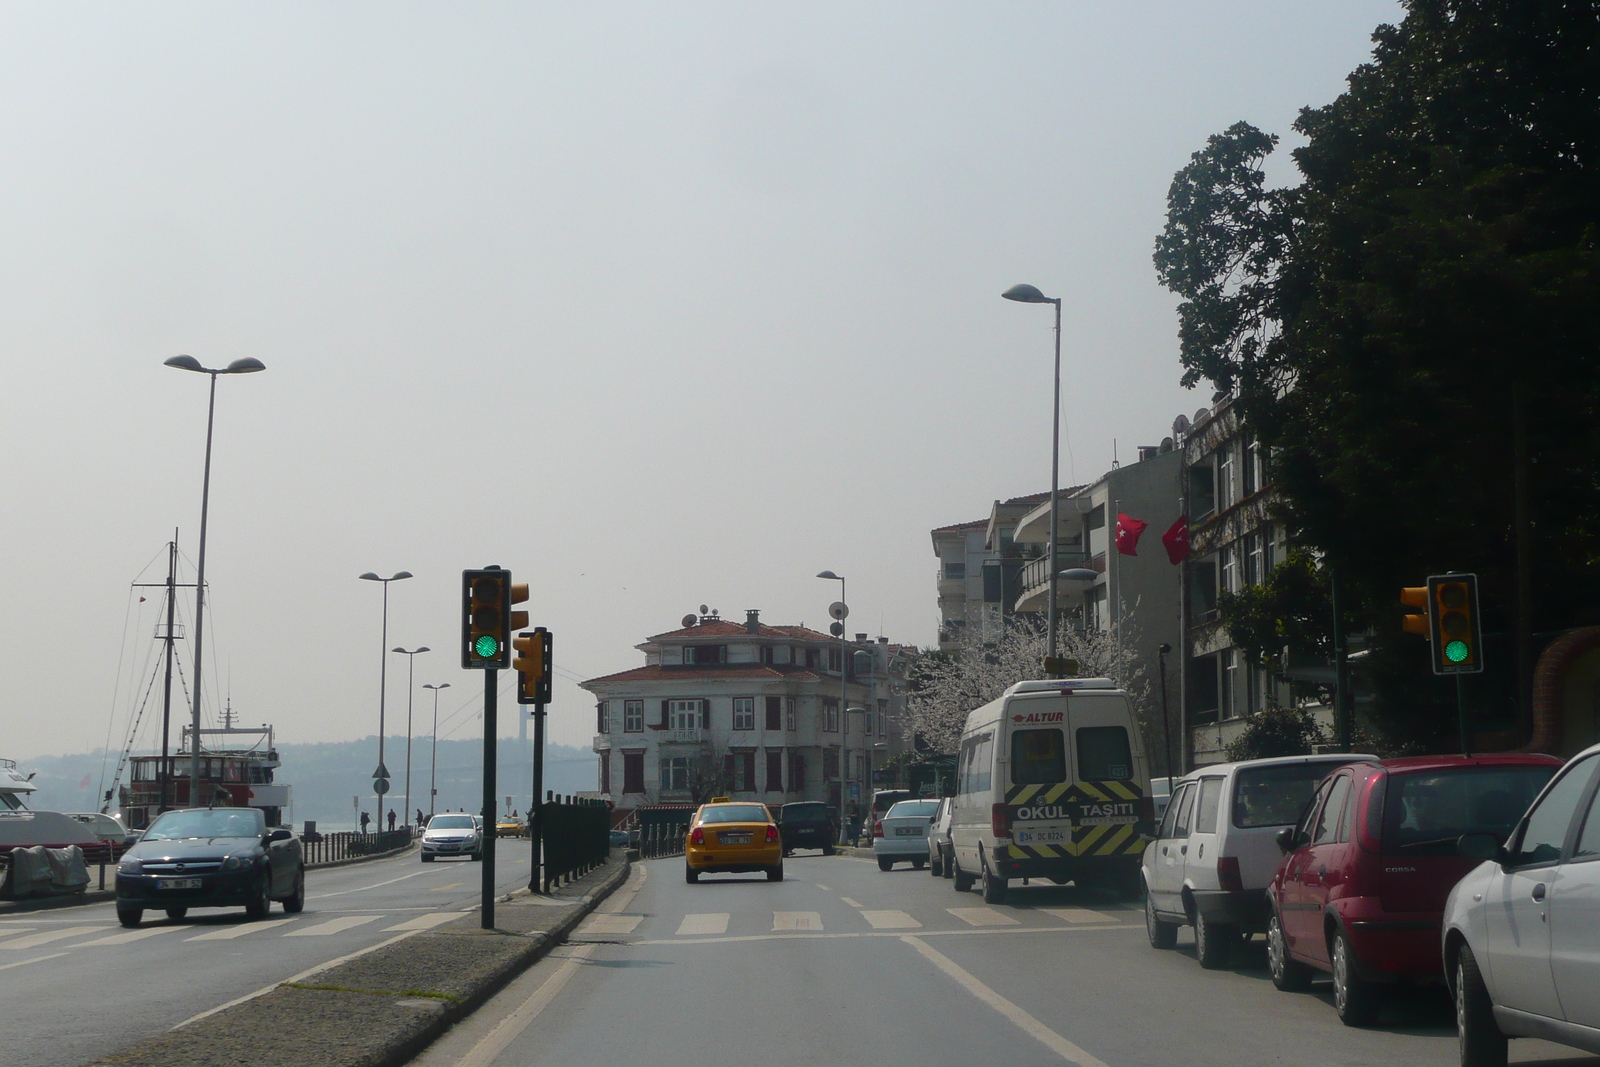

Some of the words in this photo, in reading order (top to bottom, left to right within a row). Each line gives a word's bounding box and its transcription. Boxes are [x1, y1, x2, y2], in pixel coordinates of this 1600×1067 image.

[1026, 712, 1064, 722] ALTUR
[1017, 806, 1069, 820] OKUL
[1080, 803, 1134, 818] TAŞITI
[1024, 832, 1033, 841] 34
